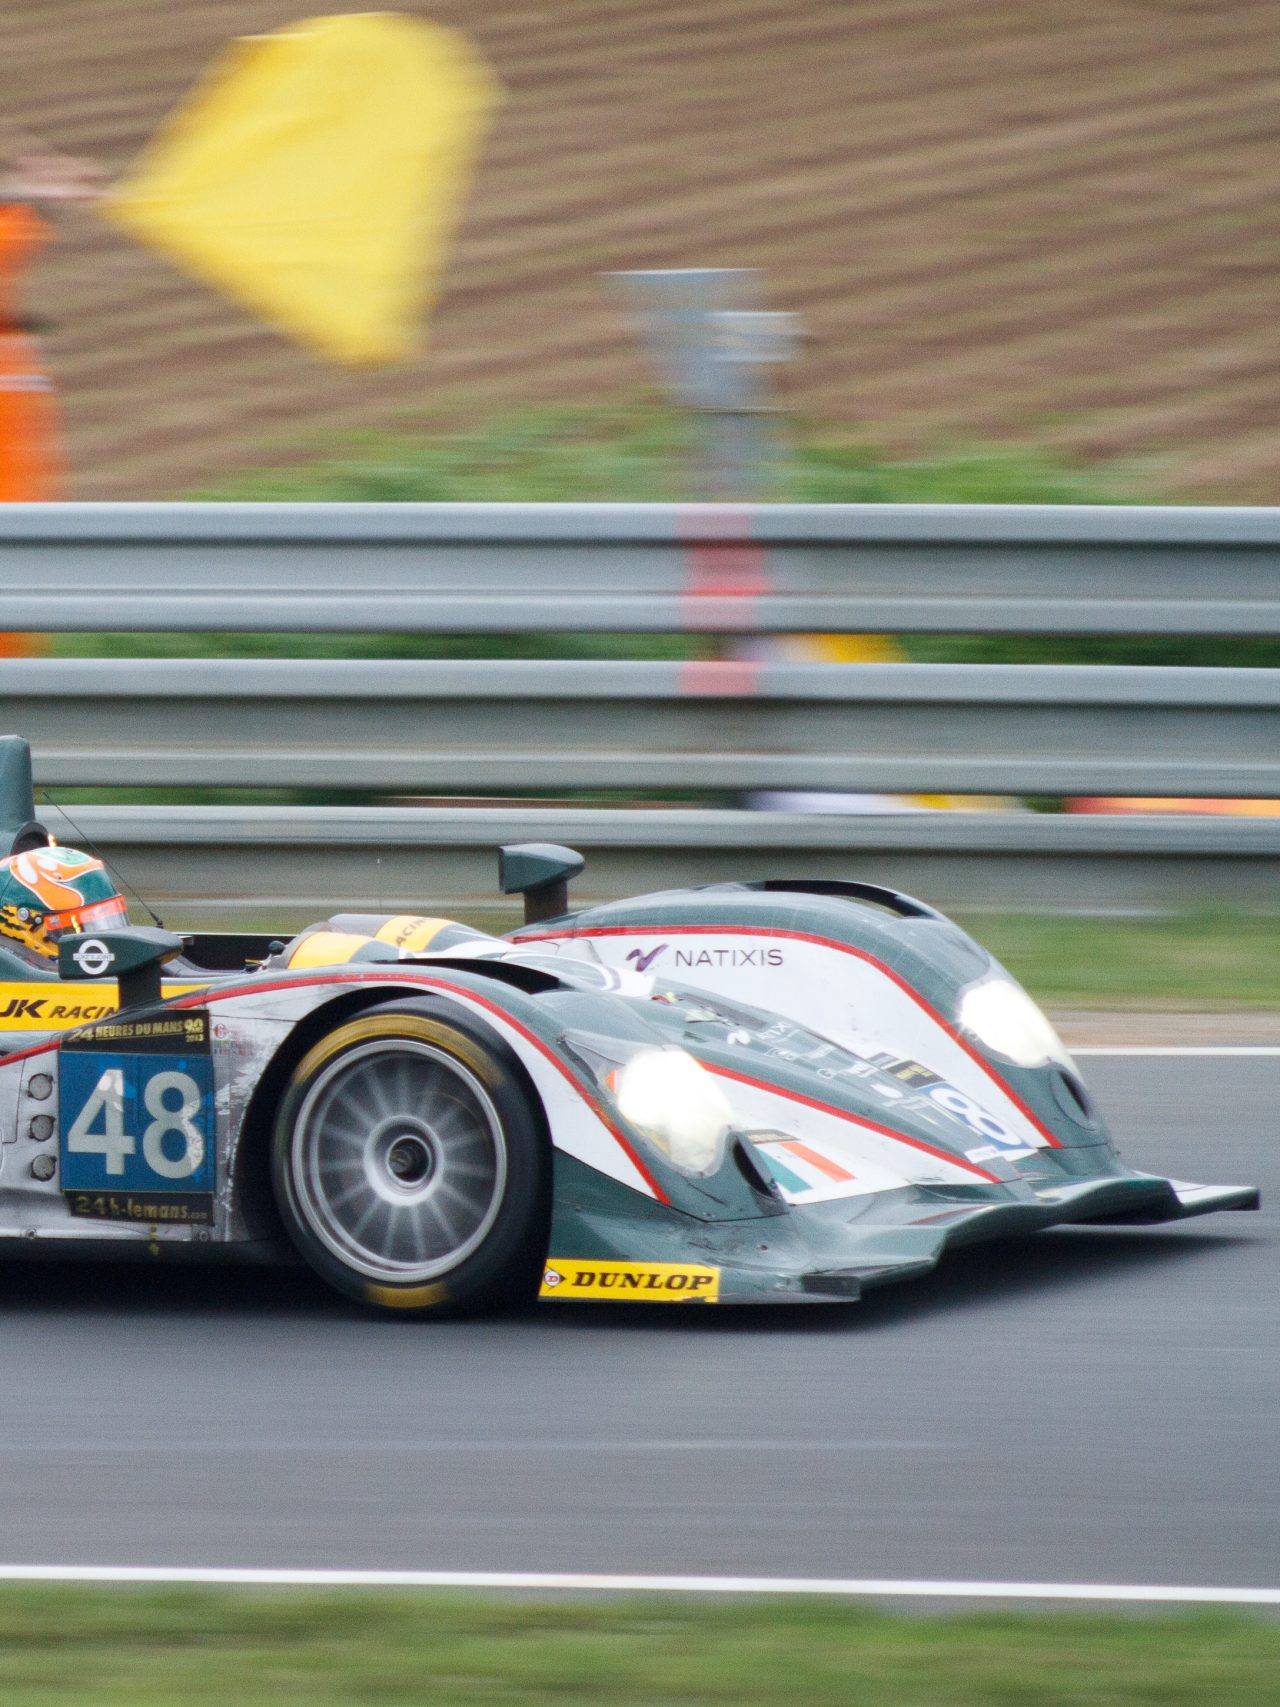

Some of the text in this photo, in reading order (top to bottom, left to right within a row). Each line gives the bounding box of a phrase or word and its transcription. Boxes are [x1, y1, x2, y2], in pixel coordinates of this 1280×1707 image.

[675, 948, 784, 967] NATIXIS
[48, 1006, 119, 1020] RACIN
[68, 1021, 184, 1041] 24 HEURES DU MANS
[185, 1034, 205, 1042] 2013
[67, 1069, 205, 1179] 48
[930, 1087, 1023, 1146] 8
[571, 1271, 714, 1290] DUNLOP
